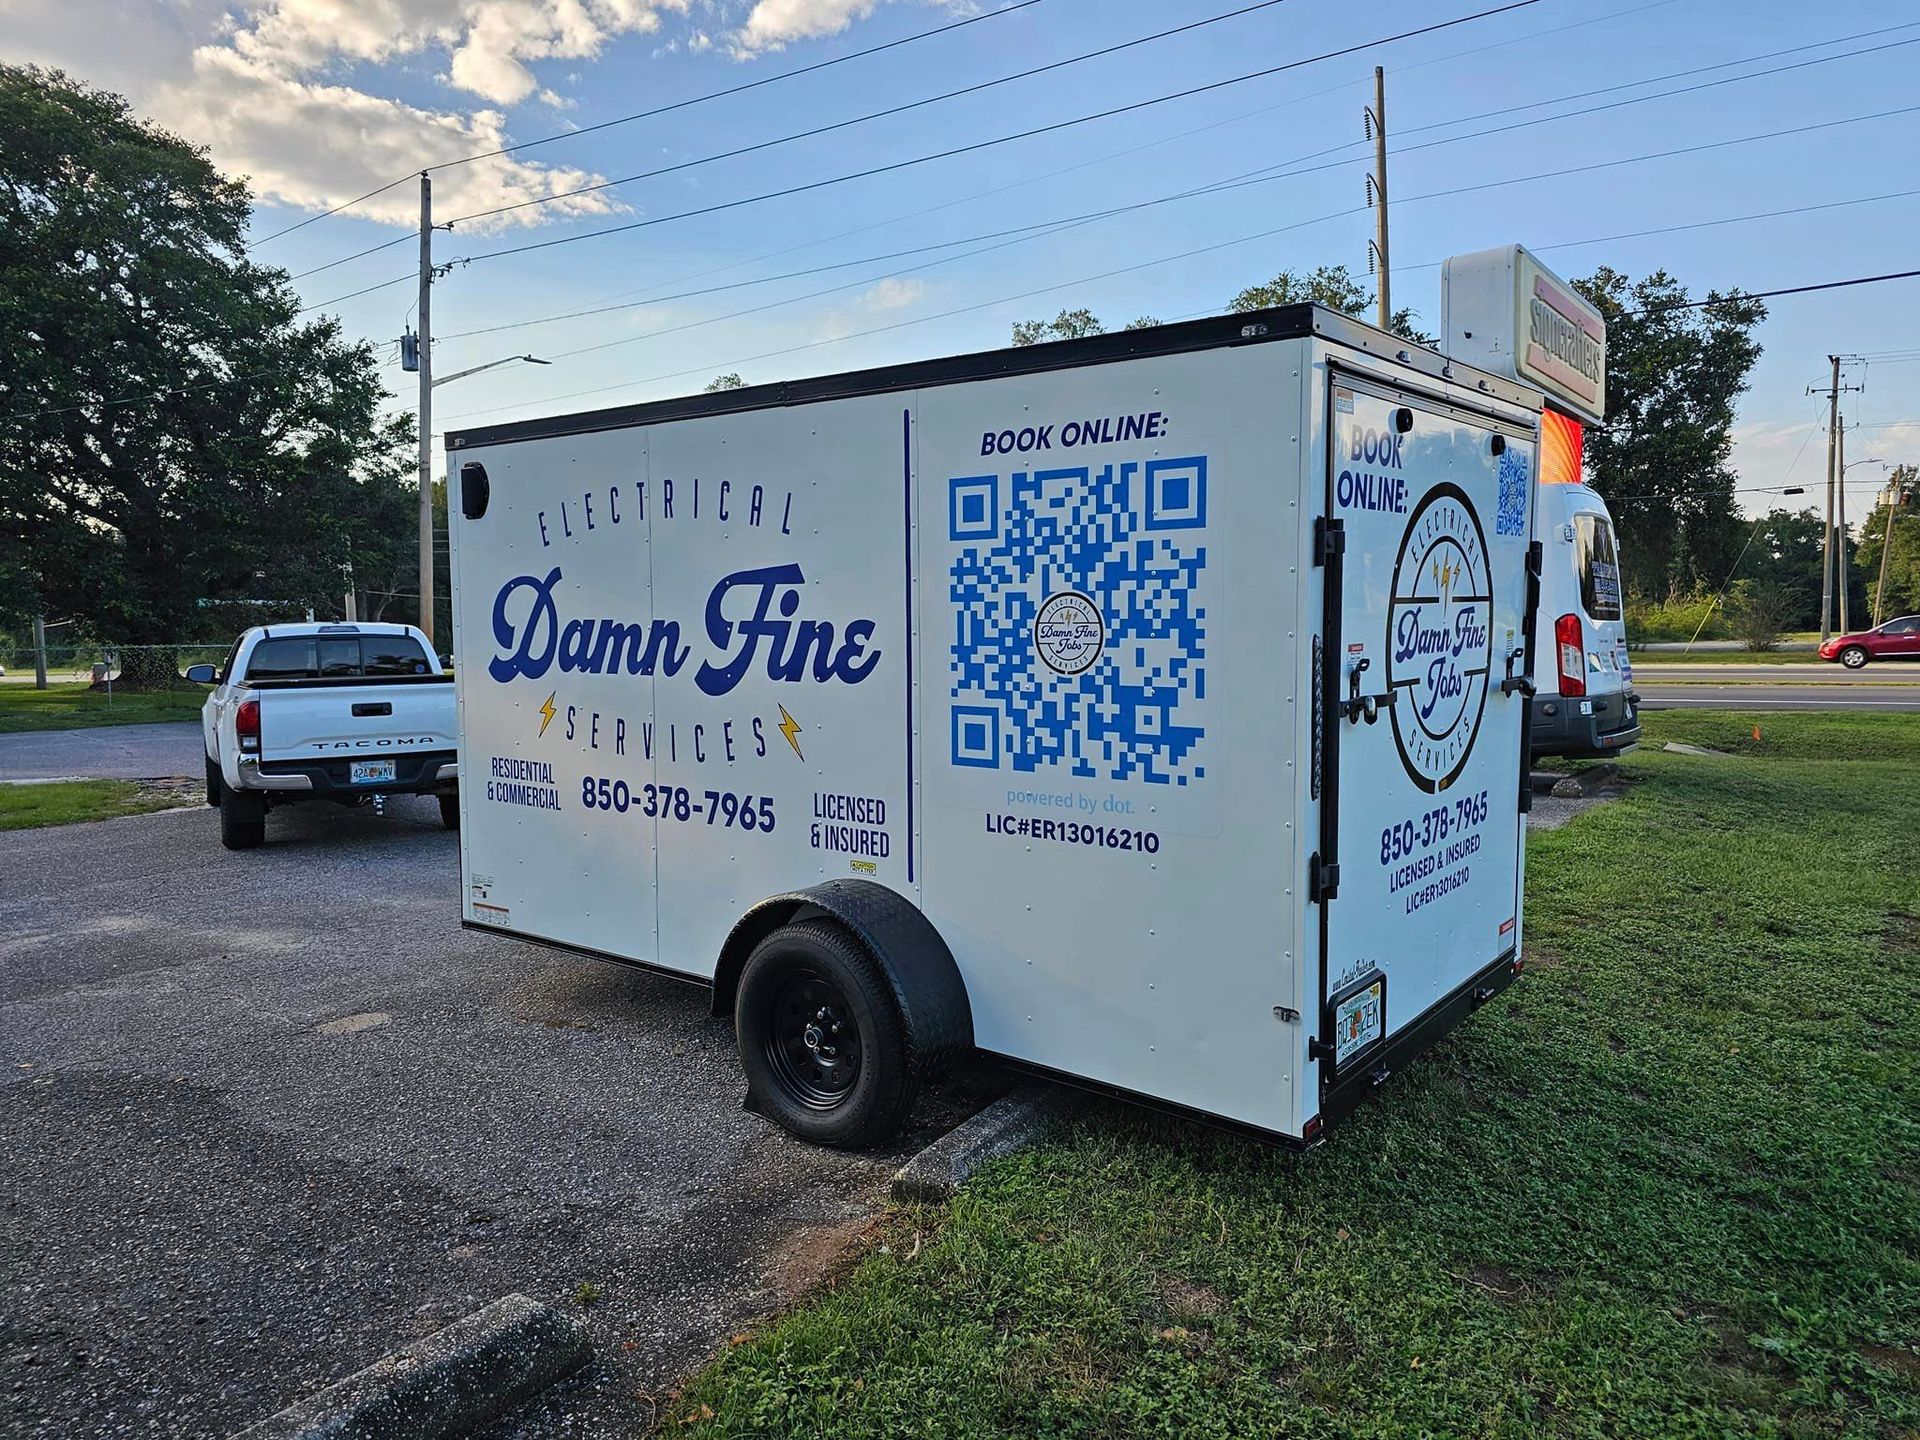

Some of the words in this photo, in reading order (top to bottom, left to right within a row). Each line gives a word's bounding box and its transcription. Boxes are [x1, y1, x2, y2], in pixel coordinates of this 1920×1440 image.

[980, 425, 1054, 456] BOOK
[1061, 411, 1169, 448] ONLINE:
[1351, 424, 1403, 469] BOOK
[537, 478, 792, 547] ELECTRICAL
[1337, 470, 1409, 514] ONLINE:
[1411, 507, 1479, 570] ELECTRICAL
[488, 566, 691, 683] Damn
[694, 563, 881, 696] Fine
[1040, 625, 1073, 638] Damn
[1074, 625, 1098, 639] Fine
[1056, 638, 1082, 654] Jobs
[1395, 606, 1450, 663] Damn
[1452, 606, 1486, 657] Fine
[1421, 656, 1462, 720] Jobs
[312, 737, 434, 750] TACOMA
[567, 706, 766, 762] SERVICES
[1409, 717, 1469, 771] SERVICES
[492, 757, 555, 784] RESIDENTIAL
[487, 780, 494, 801] &
[496, 782, 561, 811] COMMERCIAL
[582, 776, 776, 833] 850-378-7965
[813, 792, 886, 825] LICENSED
[1007, 788, 1073, 809] powered
[1078, 792, 1097, 815] by
[1103, 794, 1135, 815] dot.
[811, 823, 820, 848] &
[825, 825, 890, 858] INSURED
[985, 813, 1159, 854] LIC#ER13016210
[1380, 791, 1488, 866] 850-378-7965
[1390, 859, 1435, 893] LICENSED
[1437, 854, 1443, 870] &
[1445, 833, 1480, 866] INSURED
[1406, 866, 1469, 914] LIC#ER13016210
